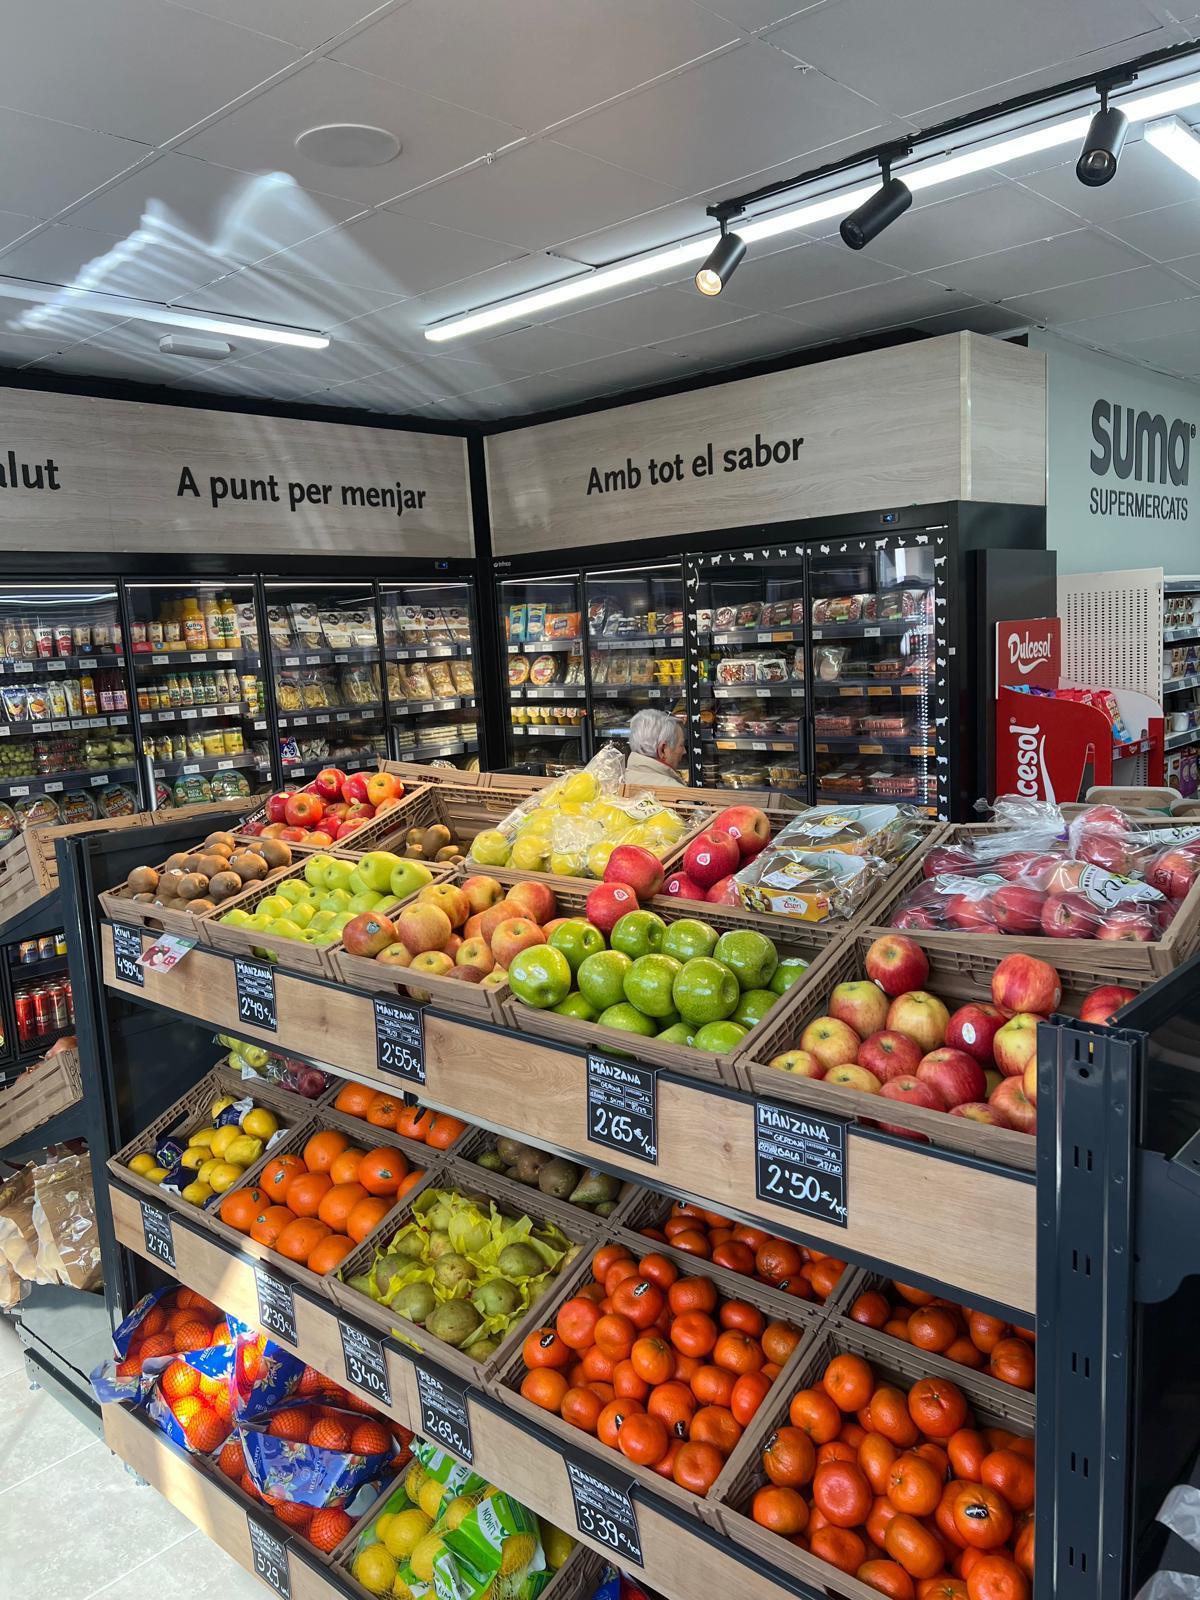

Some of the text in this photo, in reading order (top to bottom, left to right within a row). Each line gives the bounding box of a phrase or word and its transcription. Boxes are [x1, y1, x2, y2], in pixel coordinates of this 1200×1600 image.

[586, 434, 804, 495] Amb tot el sabor
[177, 467, 426, 517] A punt per menjar
[1089, 487, 1188, 521] SUPERMERCATS
[1008, 631, 1051, 664] Dulcesol
[236, 964, 272, 980] MANZANA
[376, 1004, 415, 1022] MANZANA
[590, 1060, 641, 1085] MANZANA
[759, 1108, 830, 1143] MANZANA
[346, 1326, 371, 1348] PERA
[420, 1370, 443, 1391] PERA
[569, 1465, 631, 1508] MANDARINA
